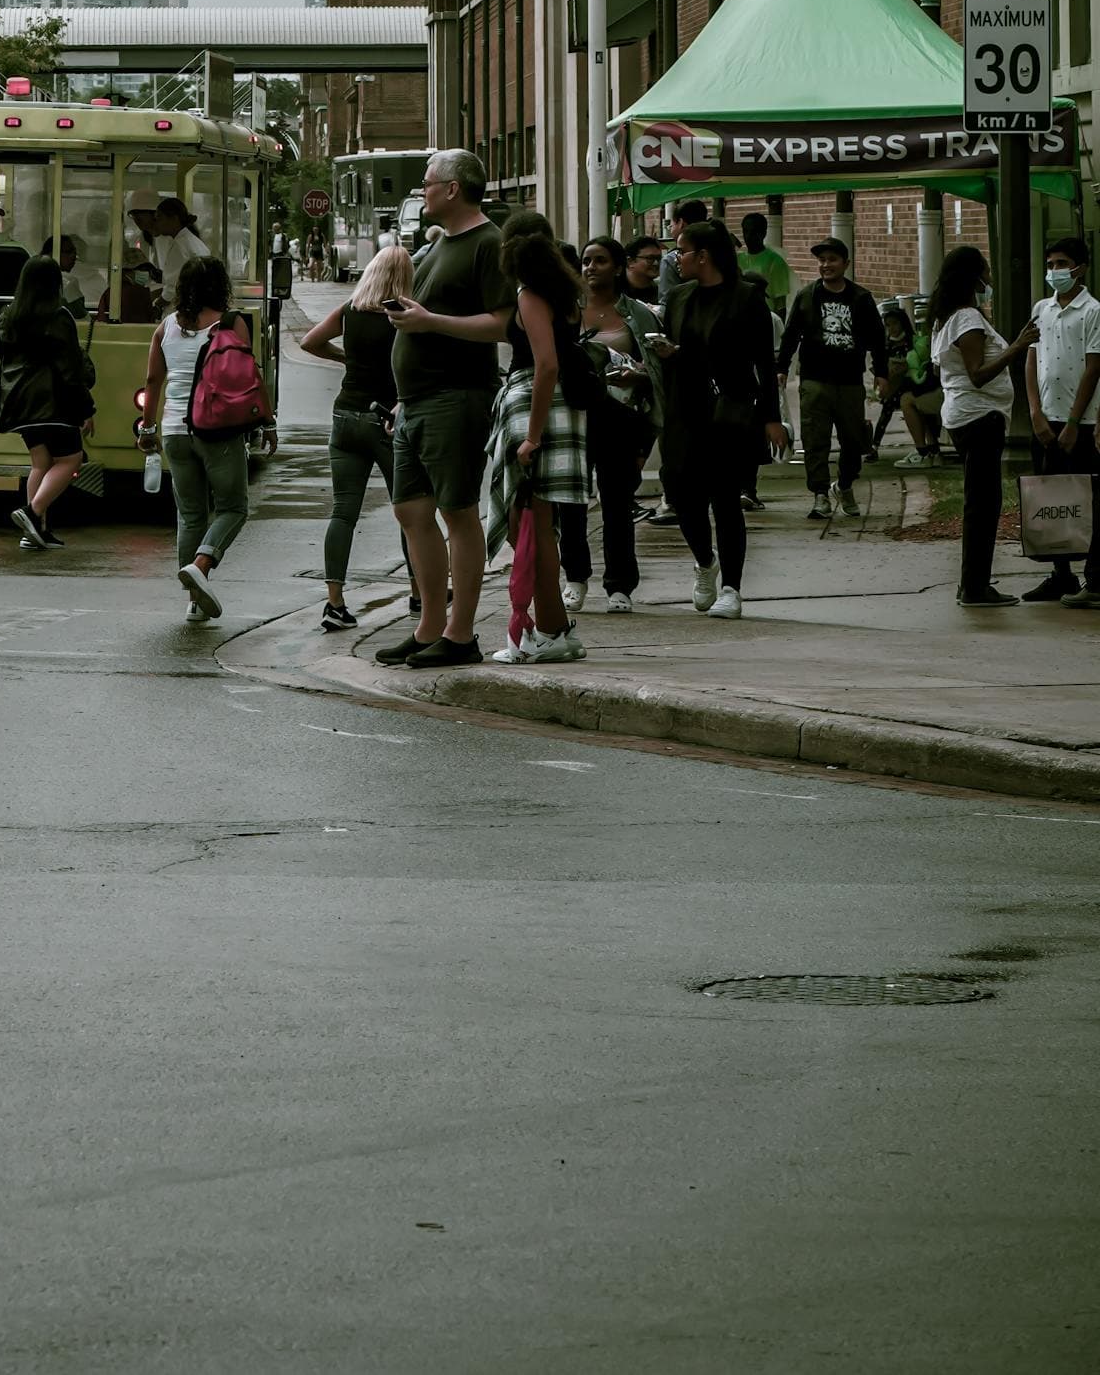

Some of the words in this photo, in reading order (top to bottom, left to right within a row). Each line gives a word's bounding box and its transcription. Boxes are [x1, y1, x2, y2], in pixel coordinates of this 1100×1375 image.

[970, 10, 1045, 27] MAXIMUM
[974, 43, 1041, 95] 30
[631, 134, 721, 168] CNE
[732, 133, 907, 164] EXPRESS
[305, 197, 329, 210] STOP
[1032, 504, 1082, 520] ARDENE
